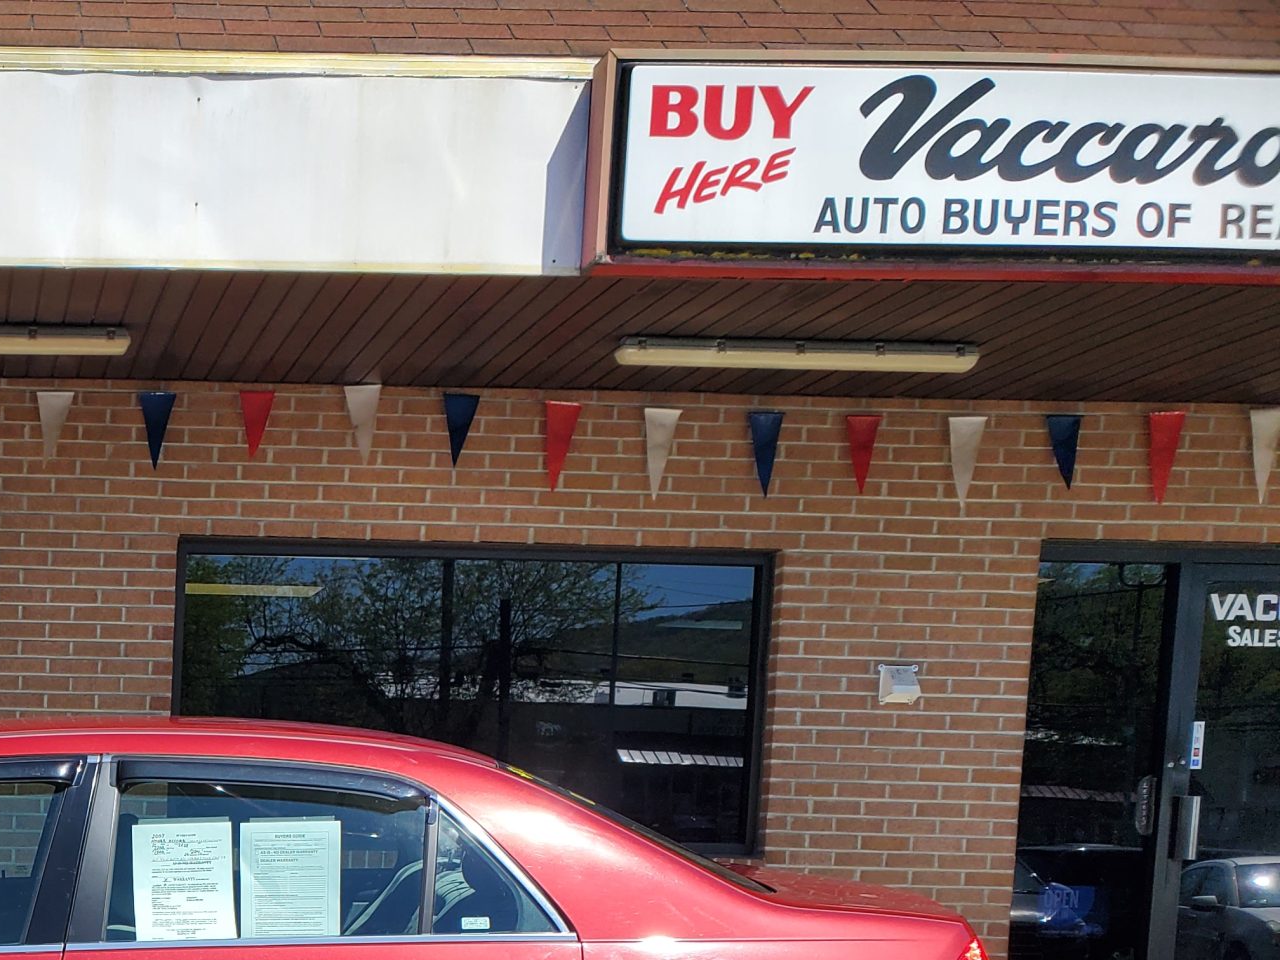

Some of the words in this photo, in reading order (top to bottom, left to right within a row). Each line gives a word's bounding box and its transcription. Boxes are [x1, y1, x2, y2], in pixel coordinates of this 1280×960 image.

[649, 84, 816, 141] BUY
[858, 74, 1280, 187] Vaccaro
[653, 146, 797, 215] HERE
[813, 196, 926, 235] AUTO
[942, 197, 1119, 238] BUYERS
[1136, 201, 1193, 239] OF
[1219, 203, 1280, 240] RE
[1210, 593, 1280, 621] VAC
[1227, 625, 1280, 647] SALE
[1043, 889, 1080, 909] OPEN
